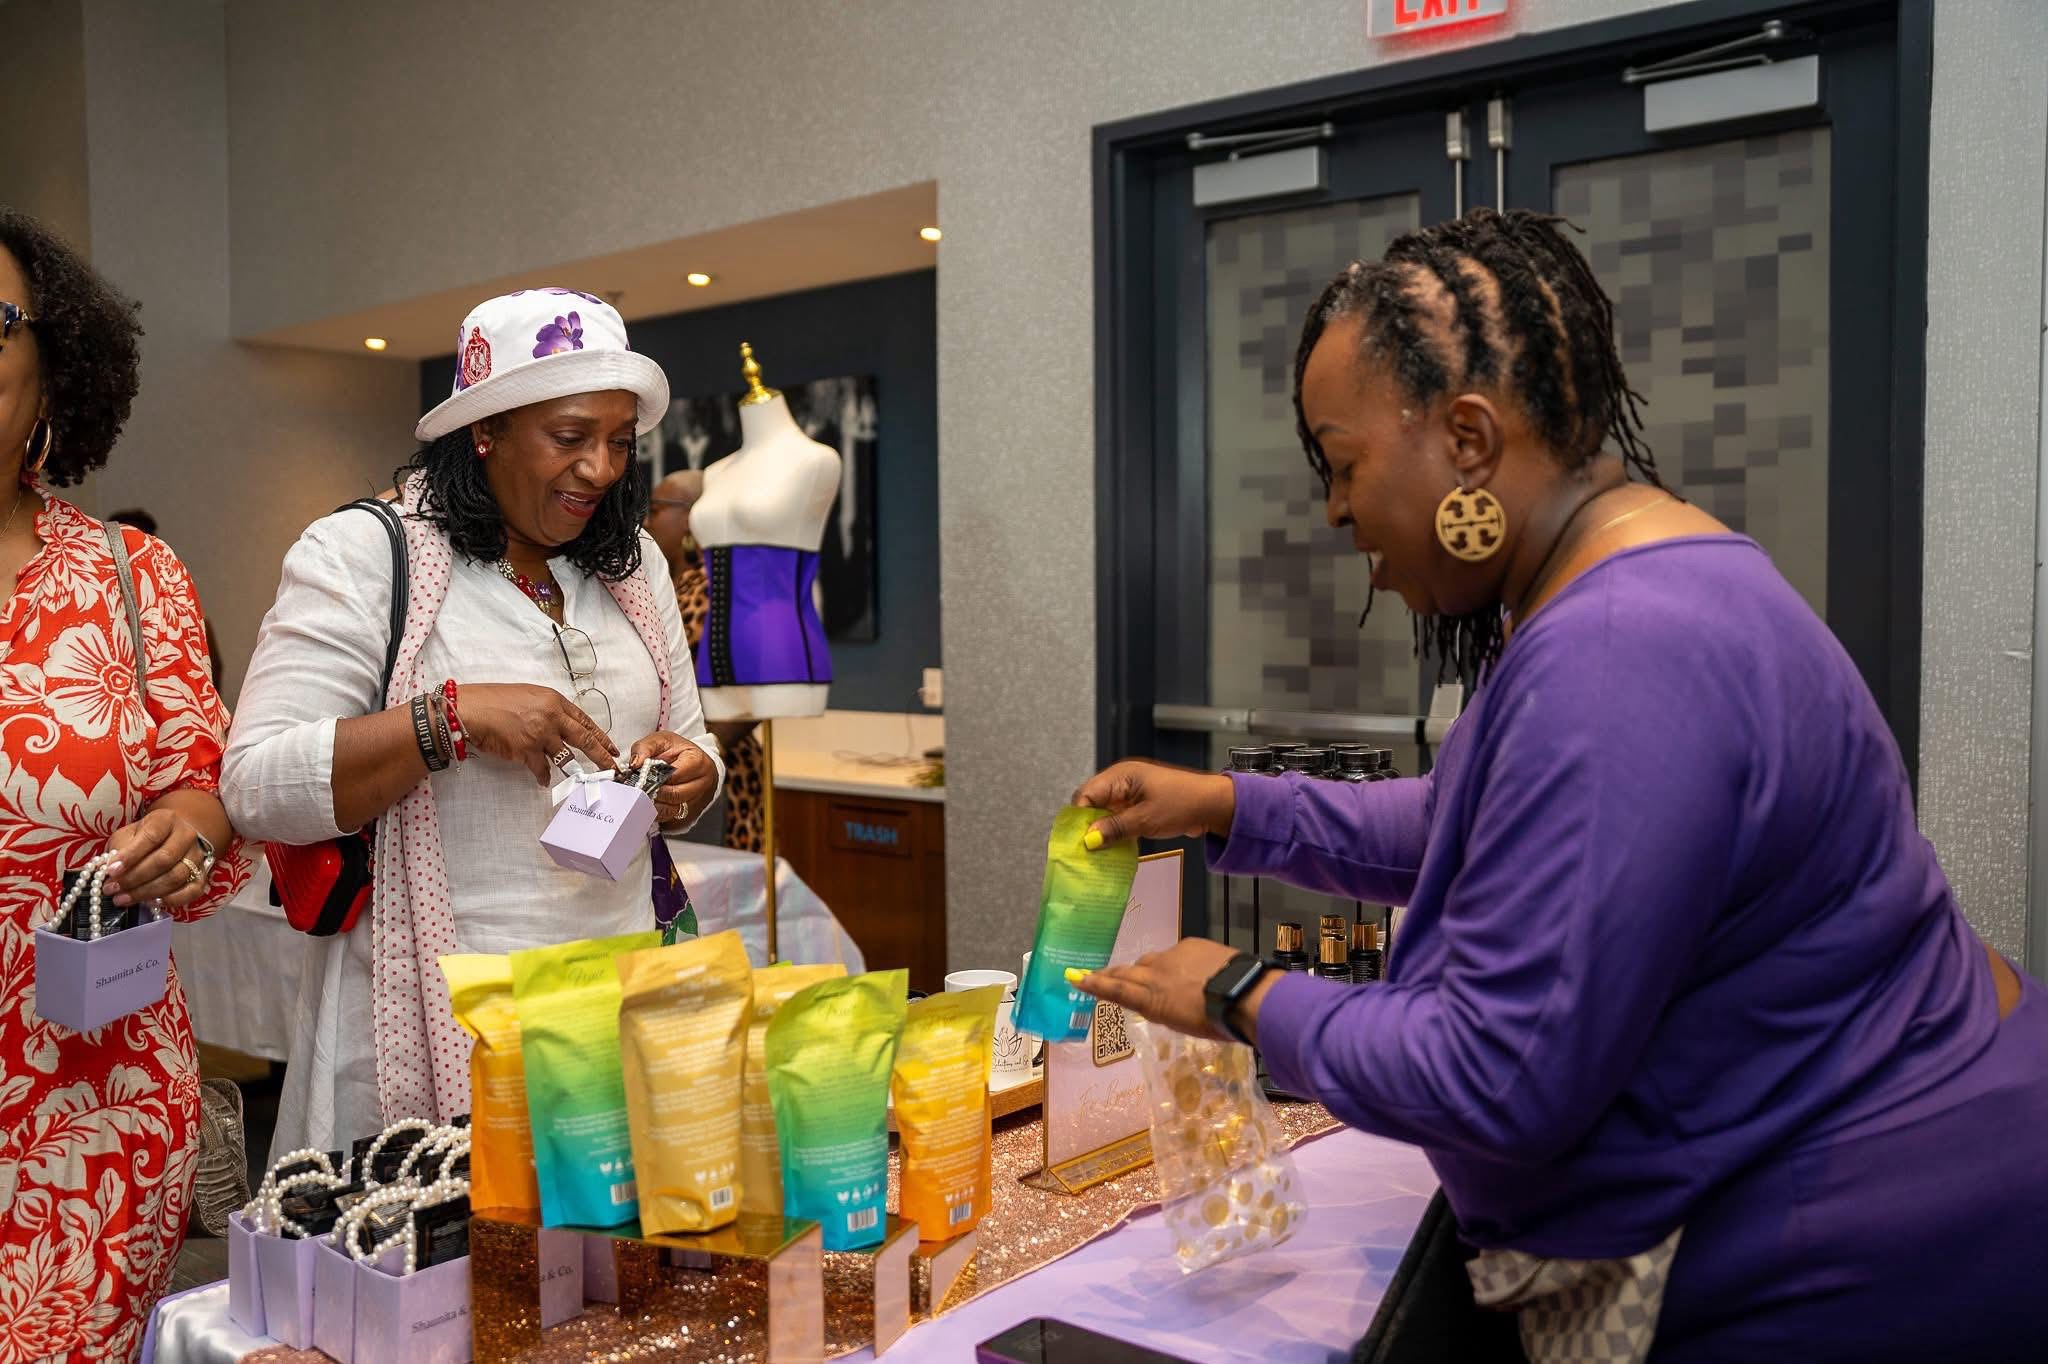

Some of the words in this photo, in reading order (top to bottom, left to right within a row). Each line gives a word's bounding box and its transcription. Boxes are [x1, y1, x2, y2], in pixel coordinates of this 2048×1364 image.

[95, 967, 134, 989] Shaunita
[135, 962, 143, 972] &
[145, 958, 160, 969] Co.
[411, 1311, 458, 1334] Shaunita
